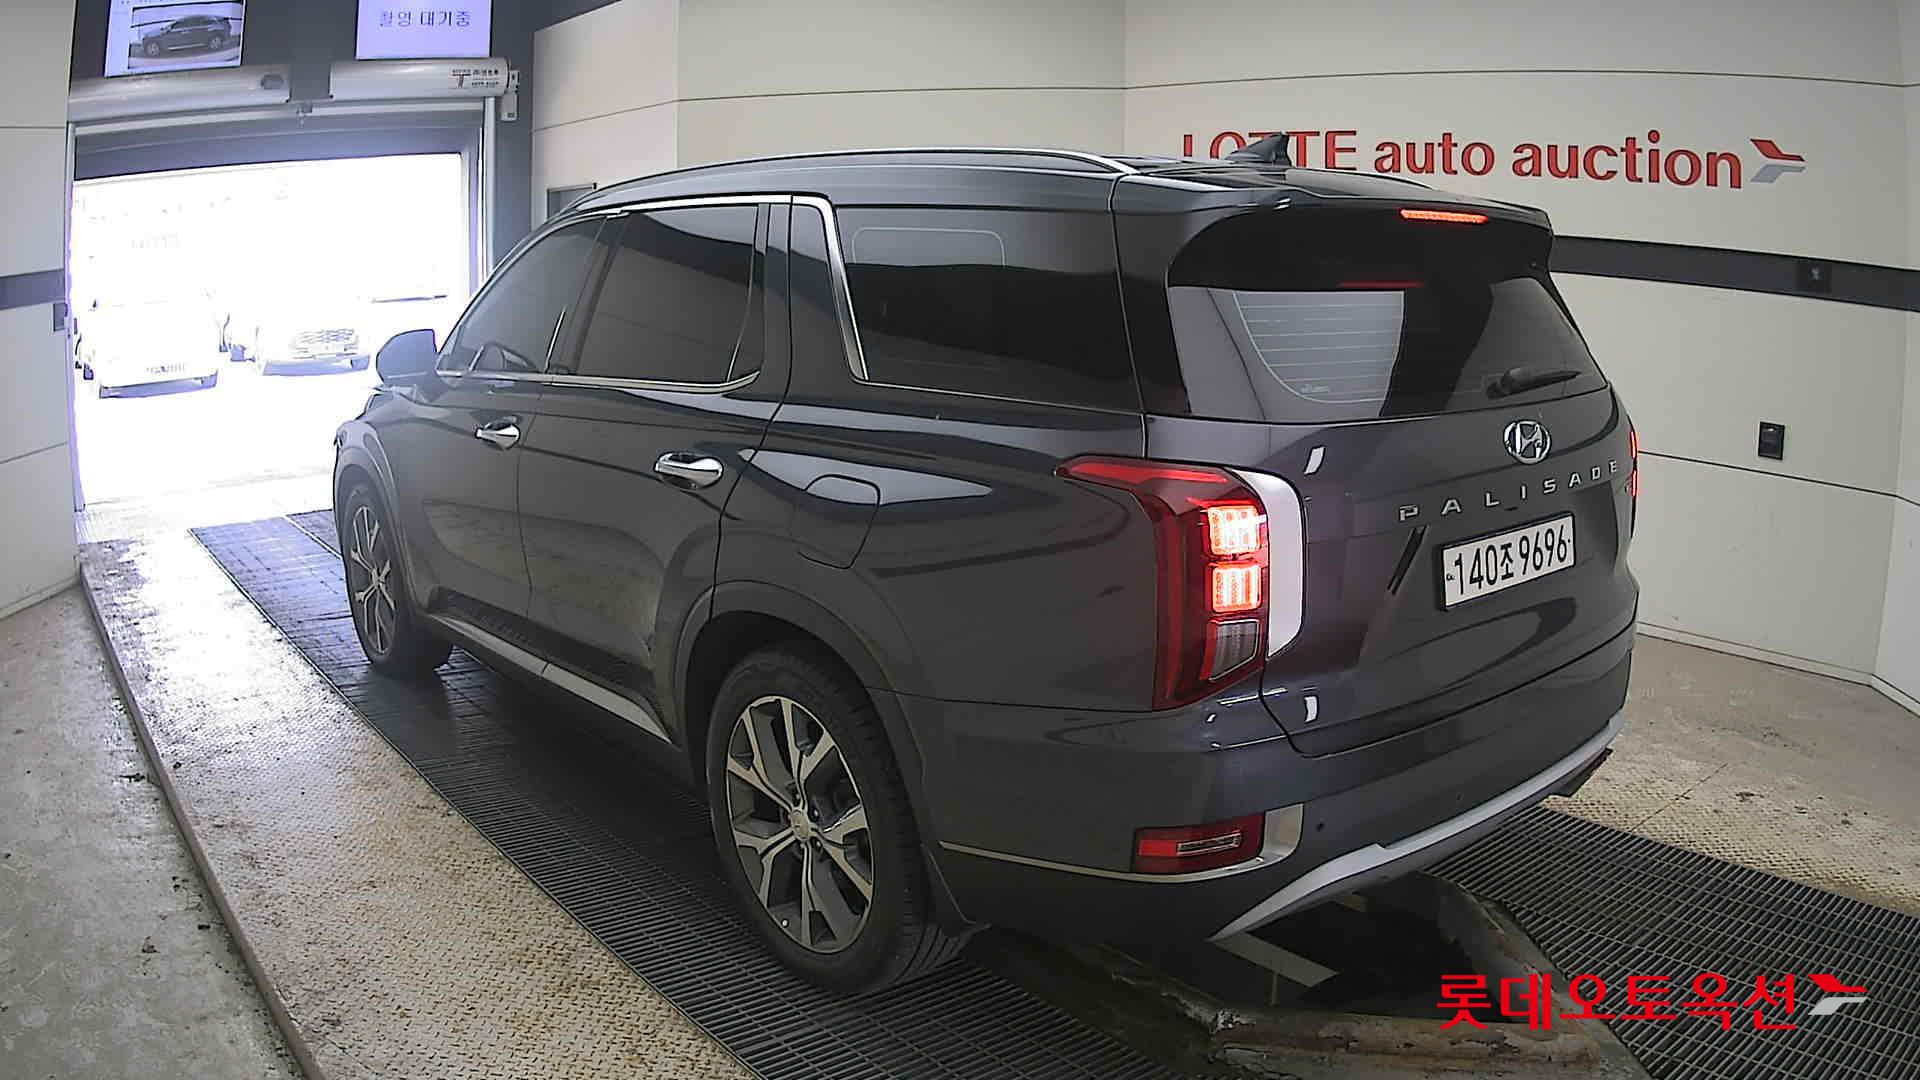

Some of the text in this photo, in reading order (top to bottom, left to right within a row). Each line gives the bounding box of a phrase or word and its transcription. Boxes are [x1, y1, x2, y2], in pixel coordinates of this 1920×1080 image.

[419, 10, 471, 27] 대기중
[1374, 130, 1496, 177] auto
[1511, 128, 1743, 190] auction
[1399, 459, 1618, 522] PALISADE
